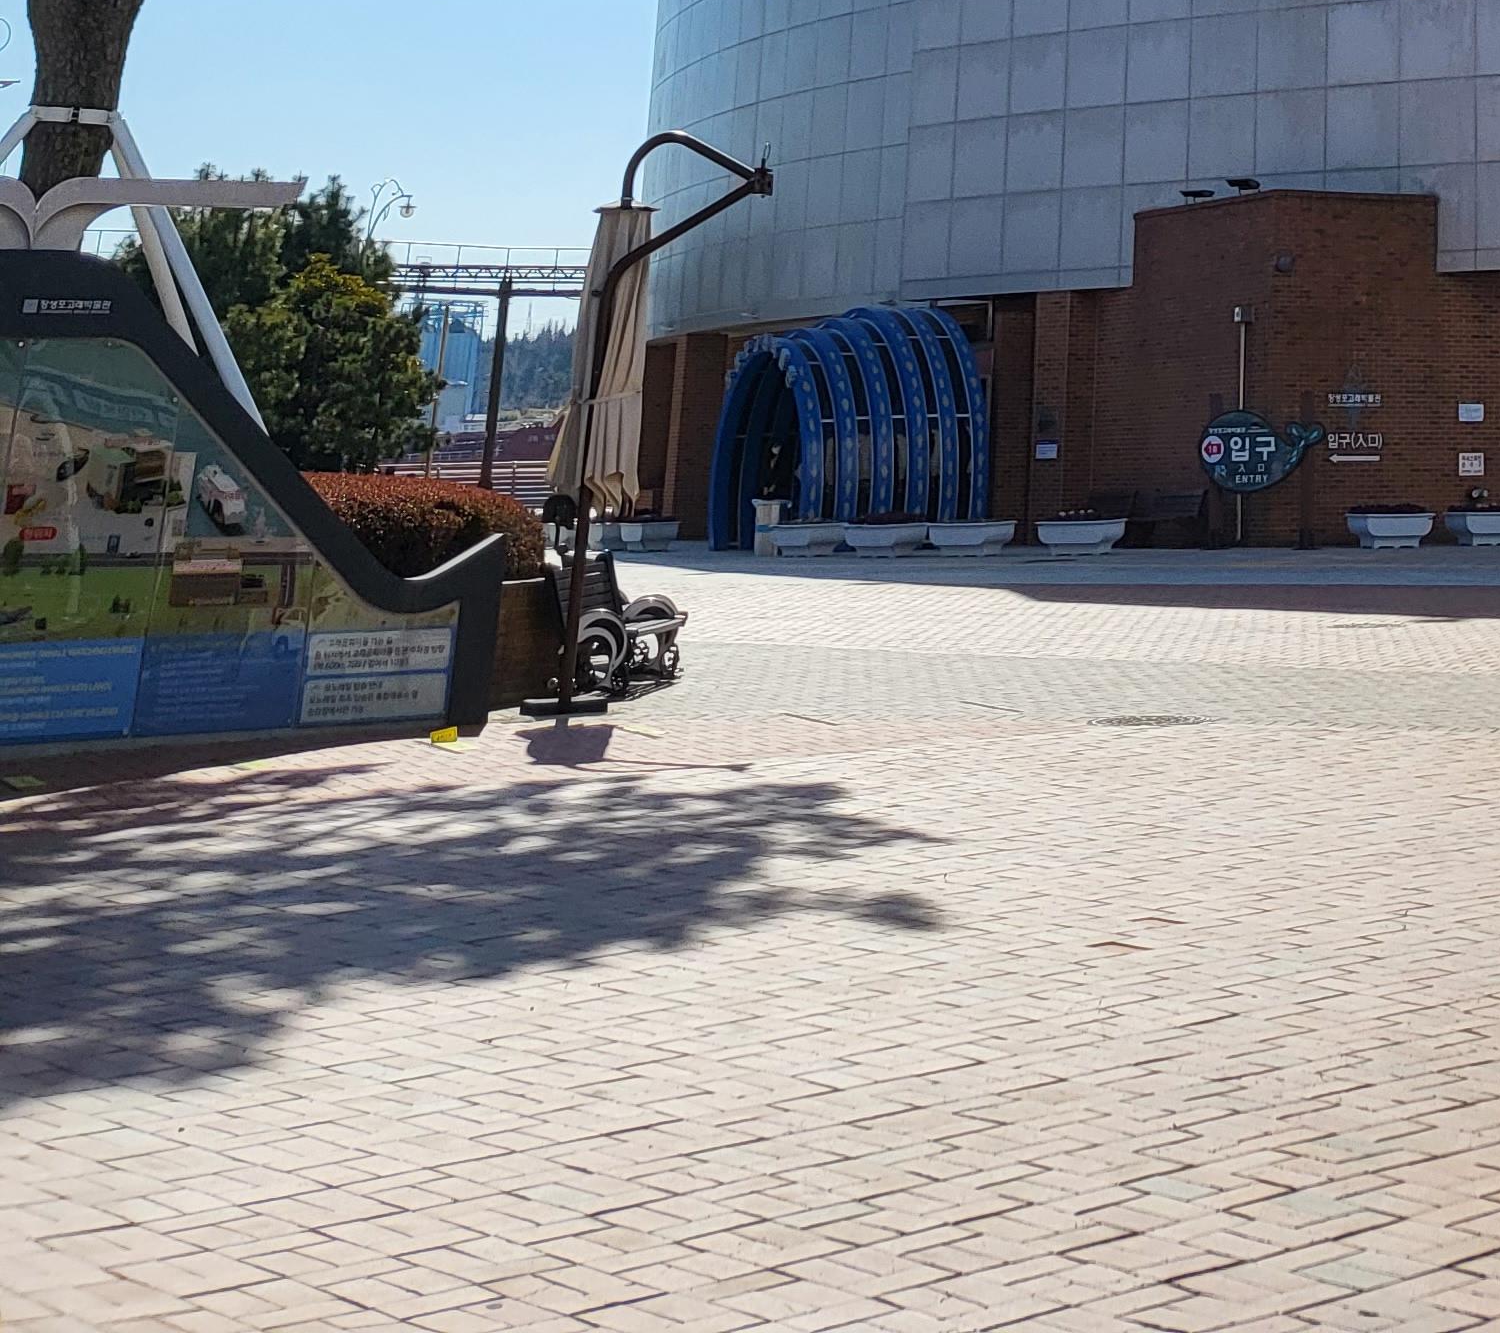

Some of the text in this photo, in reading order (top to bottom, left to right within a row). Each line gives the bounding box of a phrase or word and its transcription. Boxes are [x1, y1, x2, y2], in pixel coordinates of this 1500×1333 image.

[1229, 436, 1277, 462] 입구
[1327, 431, 1383, 450] 입구(入口)
[1235, 474, 1269, 485] ENTRY
